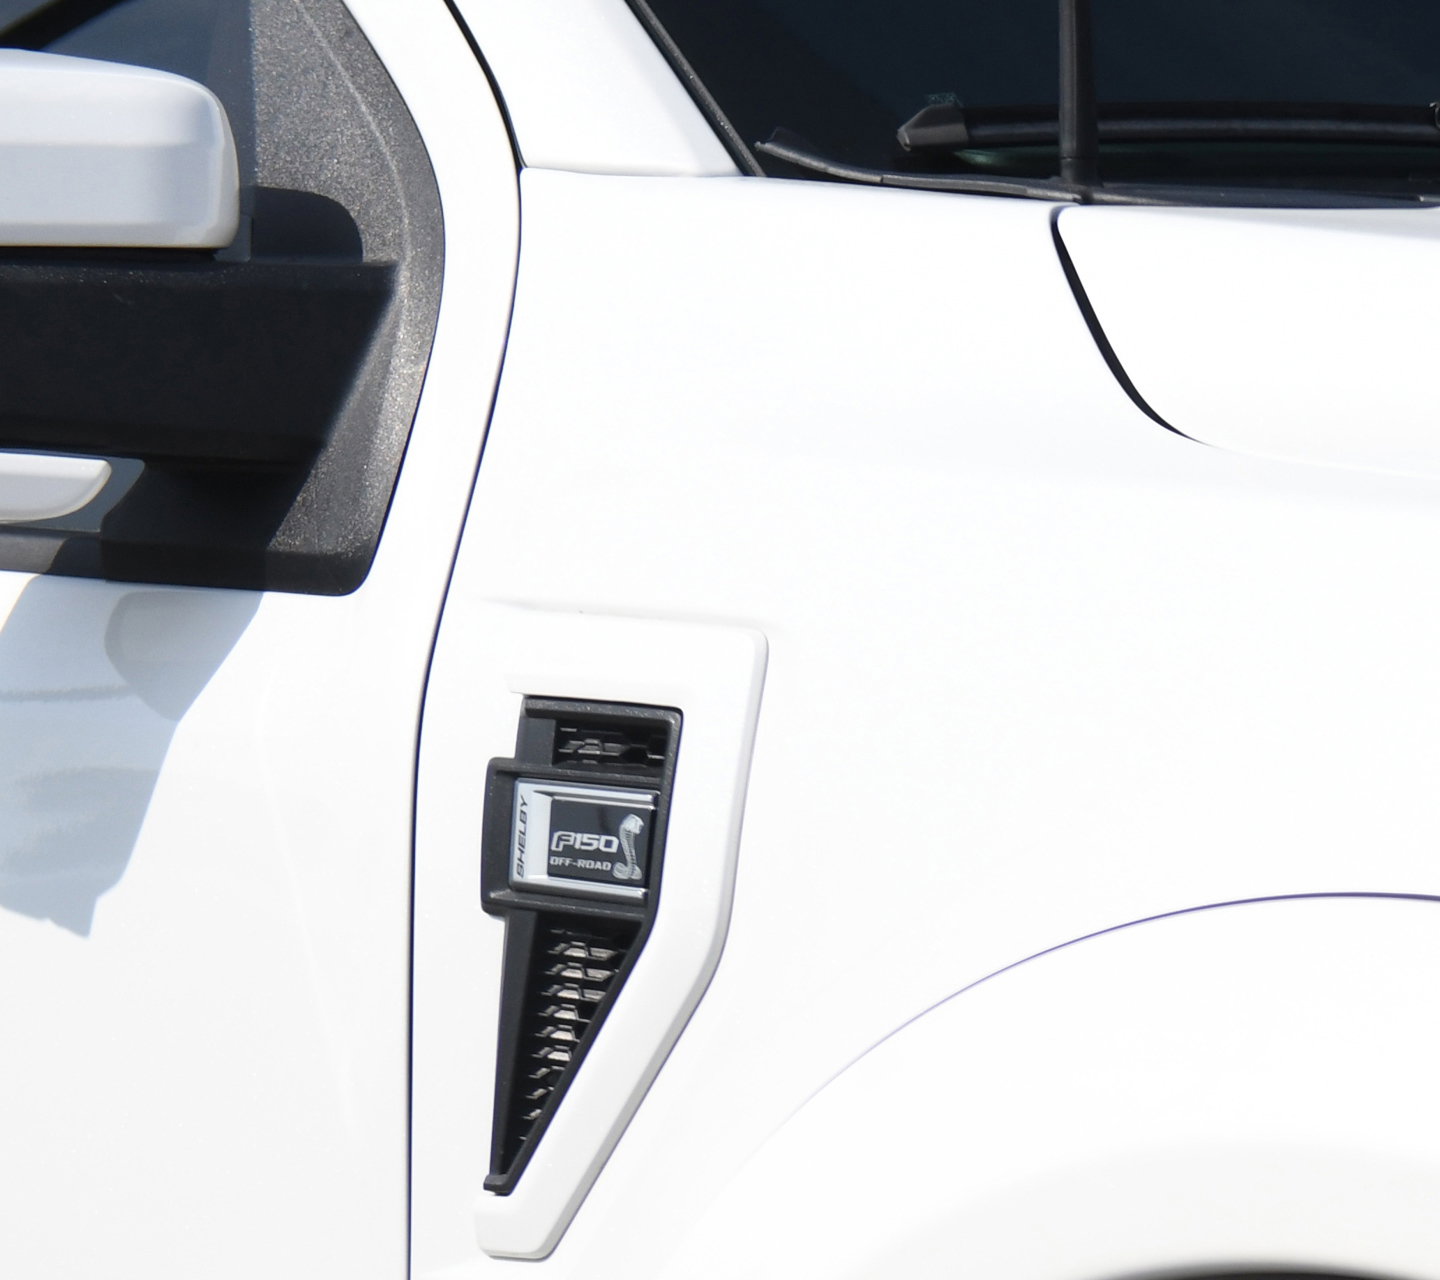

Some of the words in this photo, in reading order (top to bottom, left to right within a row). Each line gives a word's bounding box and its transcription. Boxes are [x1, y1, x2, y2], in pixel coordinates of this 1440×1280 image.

[516, 795, 528, 879] SHELBY
[551, 830, 619, 853] F150
[549, 856, 612, 871] OFF-ROAD
